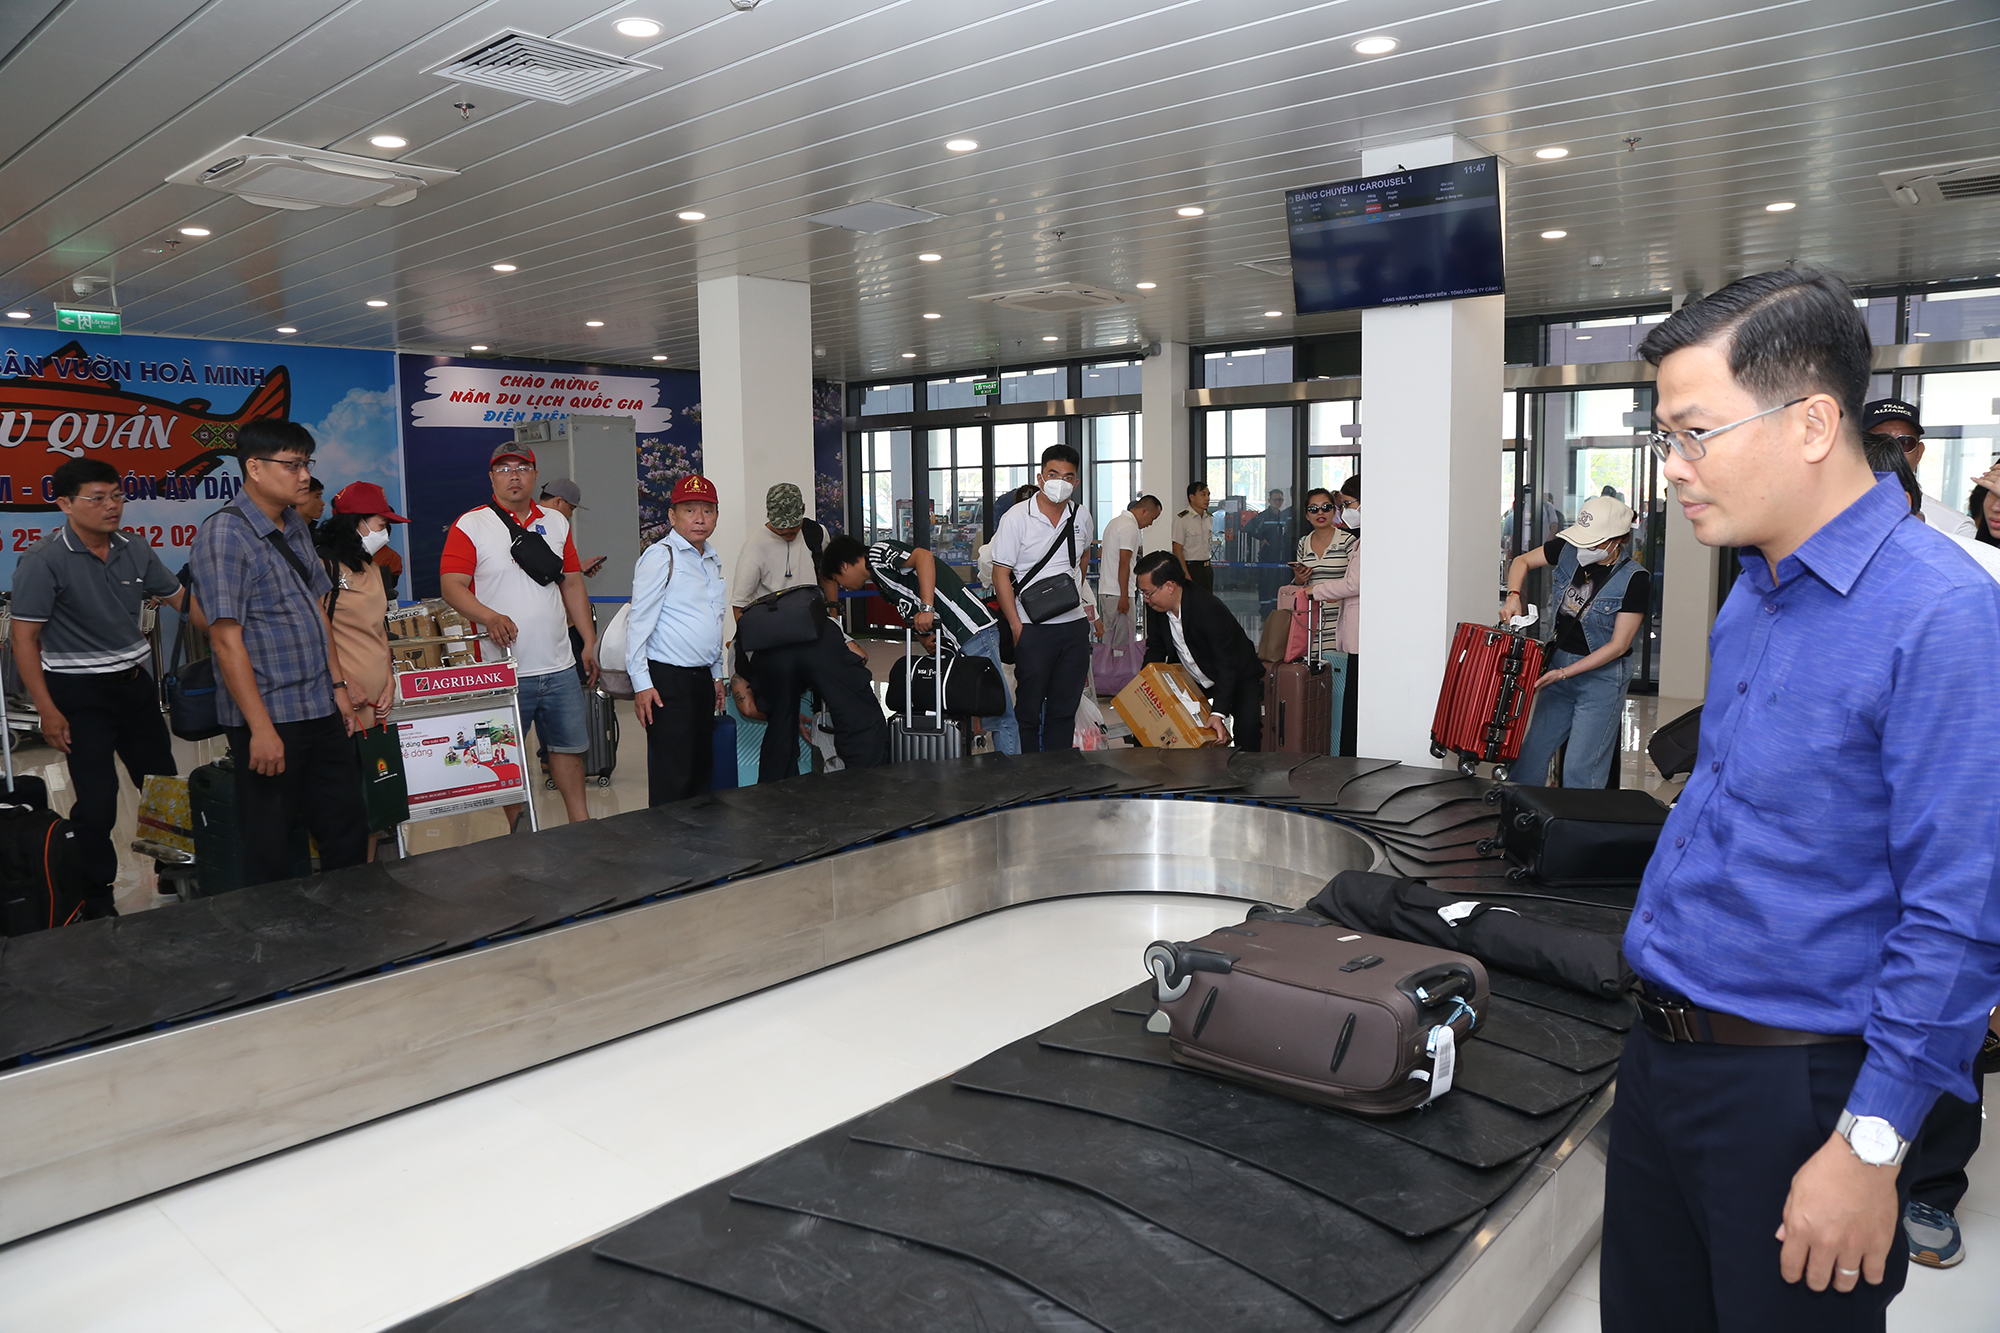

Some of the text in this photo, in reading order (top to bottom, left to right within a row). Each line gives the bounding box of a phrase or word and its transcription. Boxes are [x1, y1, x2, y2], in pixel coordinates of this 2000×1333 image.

[1463, 163, 1486, 174] 11:47
[1359, 177, 1406, 191] CAROUSEL
[1408, 175, 1413, 184] 1
[0, 348, 266, 388] ÂN VƯỜN HOÀ MINH
[500, 374, 600, 392] CHÀO MỪNG
[449, 388, 644, 411] NĂM DU LỊCH QUỐC GIA
[483, 408, 526, 426] ĐIỆN
[1874, 409, 1912, 417] ALLIANCE
[46, 404, 178, 458] QUÁN
[119, 470, 157, 501] ÓN
[165, 470, 197, 501] ĂN
[1565, 588, 1585, 606] OVE
[431, 672, 504, 691] AGRIBANK
